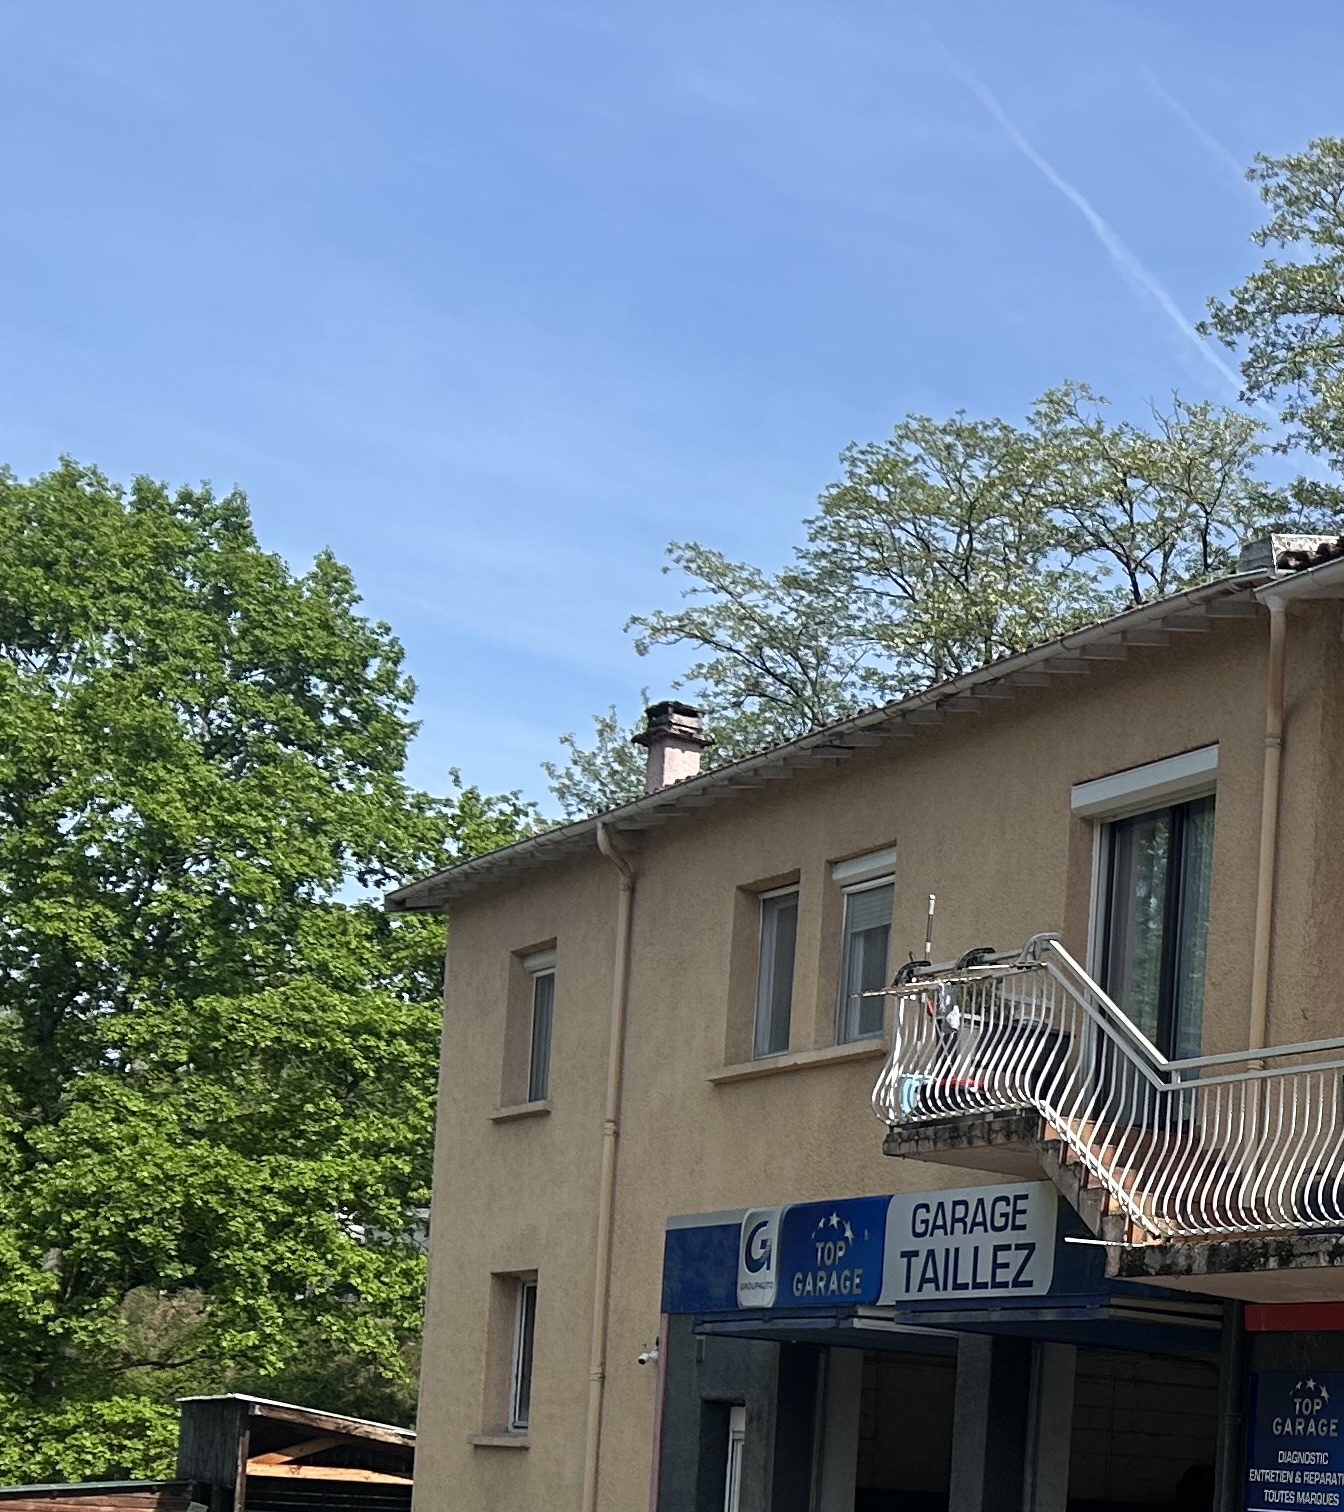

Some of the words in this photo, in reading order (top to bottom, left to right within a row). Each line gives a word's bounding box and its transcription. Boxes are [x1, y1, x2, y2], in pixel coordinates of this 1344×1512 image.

[911, 1194, 1029, 1239] GARAGE
[815, 1240, 846, 1267] TOP
[900, 1242, 1036, 1294] TAILLEZ
[792, 1268, 863, 1297] GARAGE
[1293, 1398, 1322, 1415] TOP
[1272, 1417, 1339, 1437] GARAGE
[1278, 1450, 1329, 1465] DIAGNOSTIC
[1249, 1469, 1294, 1483] ENTRETIEN
[1295, 1471, 1301, 1484] &
[1264, 1489, 1295, 1503] TOUTES
[1296, 1491, 1339, 1506] MARQUES
